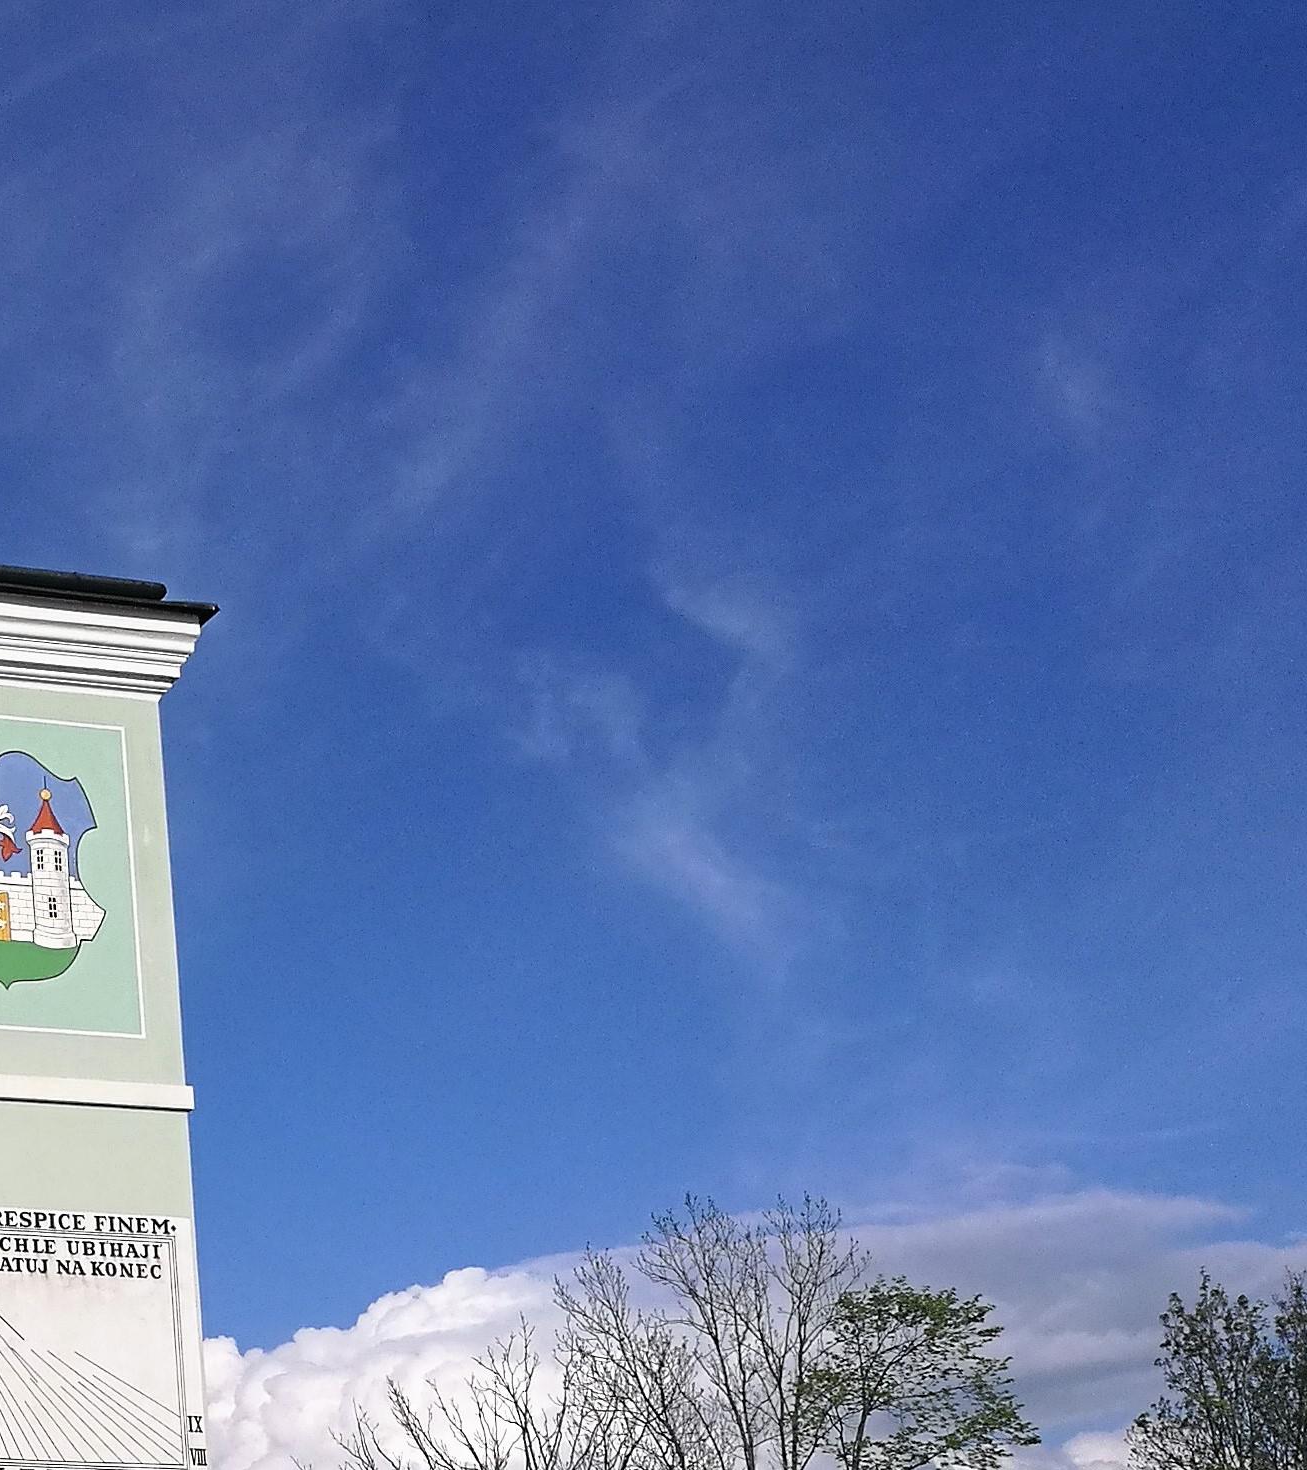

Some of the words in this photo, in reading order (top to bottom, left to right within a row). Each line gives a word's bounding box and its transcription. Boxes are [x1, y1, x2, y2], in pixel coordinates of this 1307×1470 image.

[66, 1240, 163, 1260] UBÍHAJÍ
[56, 1259, 86, 1276] NA
[90, 1260, 162, 1280] KONEC
[187, 1415, 203, 1433] IX
[189, 1448, 208, 1466] VIII
